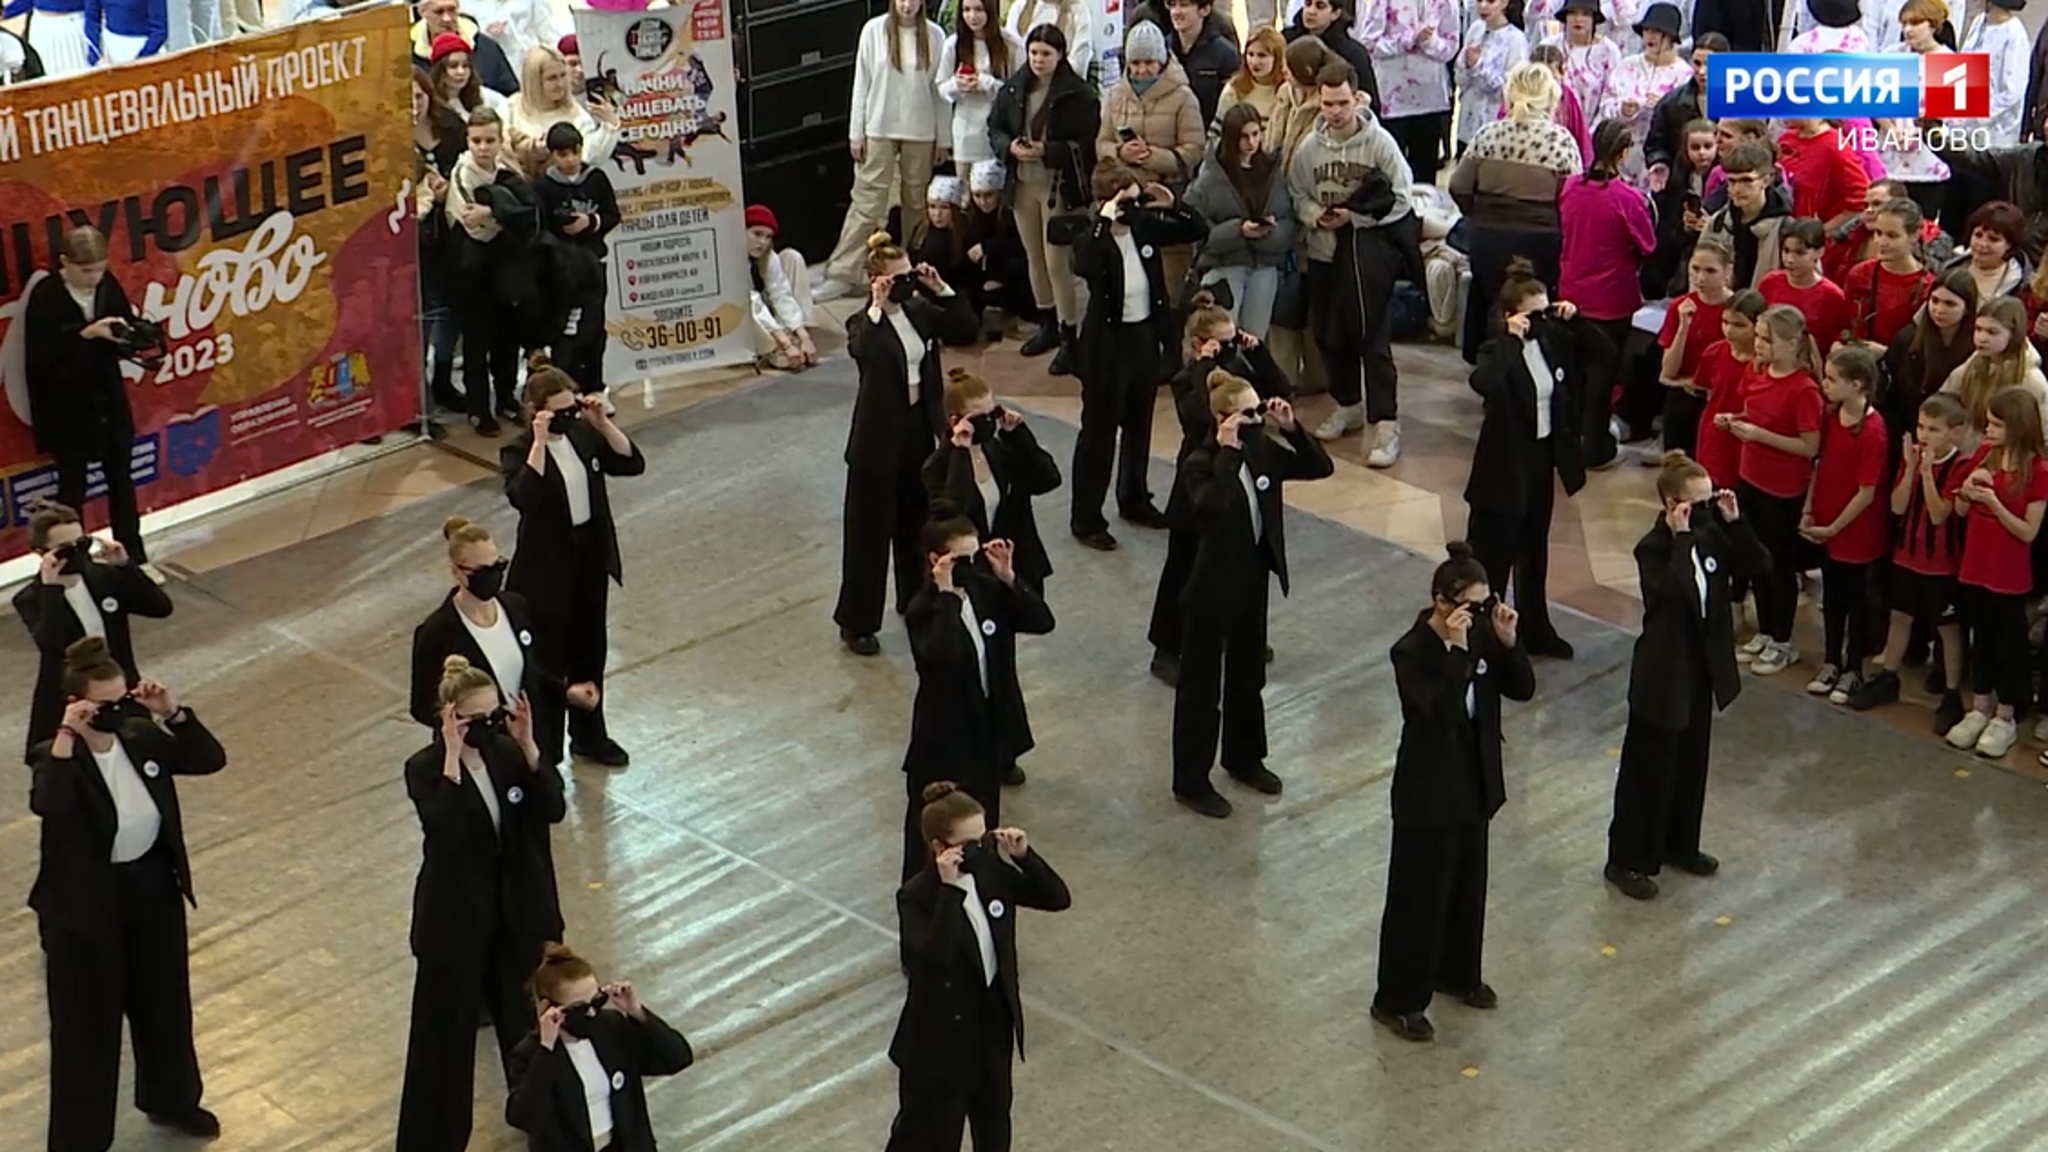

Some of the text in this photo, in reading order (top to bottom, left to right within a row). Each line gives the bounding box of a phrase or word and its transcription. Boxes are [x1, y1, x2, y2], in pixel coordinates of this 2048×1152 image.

[25, 54, 260, 154] ТАНЦЕВАЛЬНЫЙ
[266, 36, 369, 99] ПРОЕКТ
[616, 95, 706, 119] АНЦЕВАТЬ
[0, 134, 369, 298] ЦУЮЩЕЕ
[647, 316, 723, 349] 36-00-91
[153, 333, 235, 385] 2023
